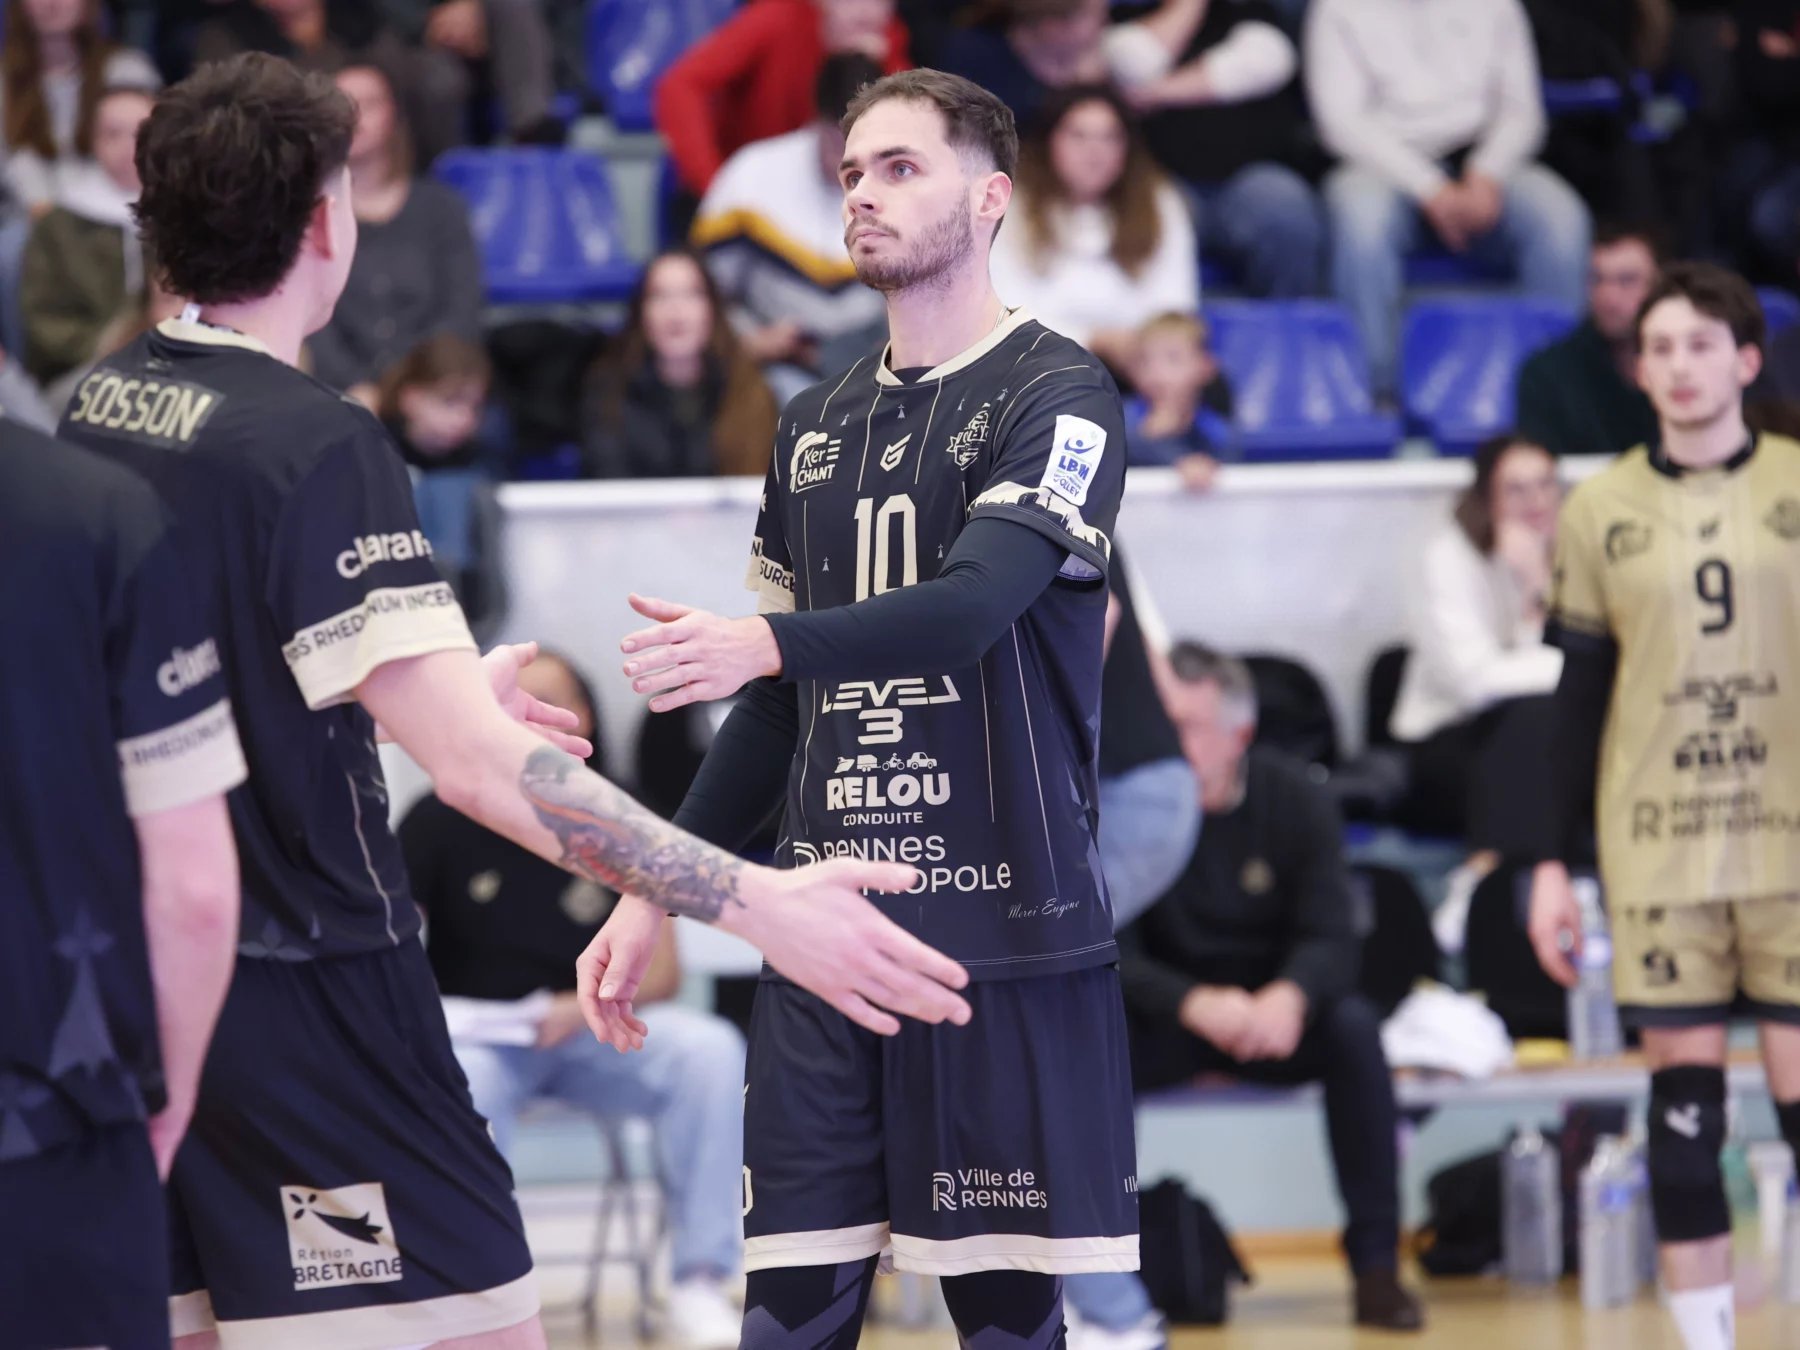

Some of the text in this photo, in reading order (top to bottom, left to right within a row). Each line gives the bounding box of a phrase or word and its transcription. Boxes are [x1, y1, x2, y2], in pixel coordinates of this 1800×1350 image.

[70, 372, 213, 441] SOSSON
[801, 447, 826, 468] Ker
[1058, 455, 1090, 481] LBM
[797, 464, 836, 486] CHANT
[854, 494, 918, 603] 10
[1696, 558, 1733, 634] 9
[857, 708, 904, 745] 3
[826, 772, 951, 811] RELOU
[843, 812, 924, 827] CONDUITE
[957, 1168, 1035, 1187] Ville de
